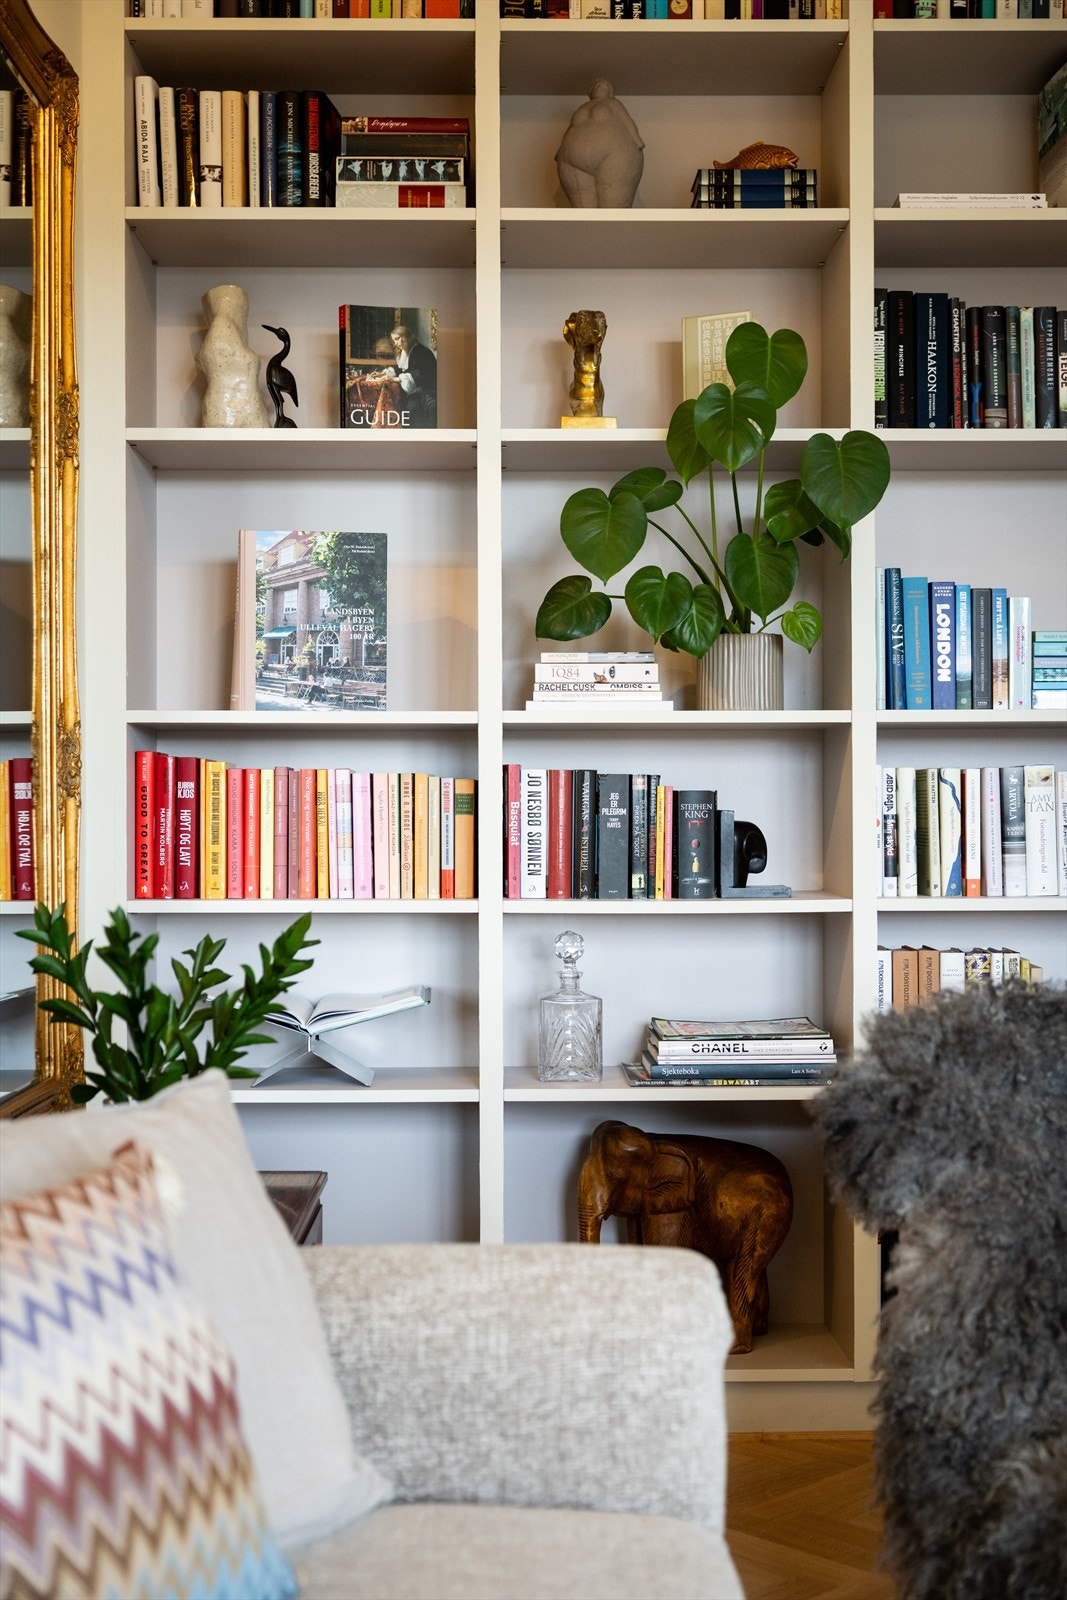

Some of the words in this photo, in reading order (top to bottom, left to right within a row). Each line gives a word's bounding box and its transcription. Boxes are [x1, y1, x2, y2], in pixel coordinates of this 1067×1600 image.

[180, 93, 189, 130] GUILLOU
[187, 105, 195, 120] JAN
[286, 101, 294, 116] JON
[309, 97, 319, 111] TOM
[141, 119, 149, 143] ABIDA
[309, 112, 319, 151] KRISTENSEN
[142, 145, 150, 163] RAJA
[309, 152, 319, 199] KORSBÆREREN
[952, 308, 960, 352] CHARTING
[874, 330, 886, 401] VERDIVURDERING
[927, 341, 937, 392] HAAKON
[350, 409, 410, 426] GUIDE
[892, 573, 900, 585] SIV
[892, 586, 900, 616] JENSEN
[340, 623, 375, 631] HAGEBY
[349, 632, 362, 640] 100
[891, 623, 904, 653] SIV
[936, 603, 952, 682] LONDON
[551, 667, 580, 680] 1Q84
[538, 683, 572, 692] RACHEL
[572, 683, 596, 692] CUSK
[527, 773, 542, 787] JO
[886, 773, 894, 793] ABID
[140, 785, 148, 817] GOOD
[177, 789, 194, 799] KJOS
[317, 791, 326, 806] HØR
[581, 781, 590, 821] VARGAS
[608, 792, 620, 801] JEG
[884, 793, 894, 812] RAJA
[1031, 793, 1053, 802] AMY
[403, 801, 410, 809] B.
[527, 790, 542, 827] NESBØ
[601, 807, 627, 816] PILEGRIM
[610, 800, 619, 808] ER
[680, 803, 713, 811] STEPHEN
[1008, 786, 1018, 821] ARVOLA
[1026, 801, 1055, 812] TAN
[179, 809, 191, 832] HØYT
[403, 809, 411, 831] RAGDE
[684, 810, 709, 819] KING
[141, 823, 148, 837] TO
[510, 801, 520, 847] Basquiat
[634, 826, 640, 835] PÅ
[180, 833, 191, 845] OG
[292, 831, 298, 839] PÅ
[1039, 818, 1047, 863] Forundringens
[527, 831, 542, 876] SØNNEN
[581, 836, 589, 871] ISTIDER
[885, 835, 895, 856] skyld
[179, 846, 191, 867] LAVT
[691, 1043, 748, 1053] CHANEL
[661, 1067, 699, 1076] Sjekteboka
